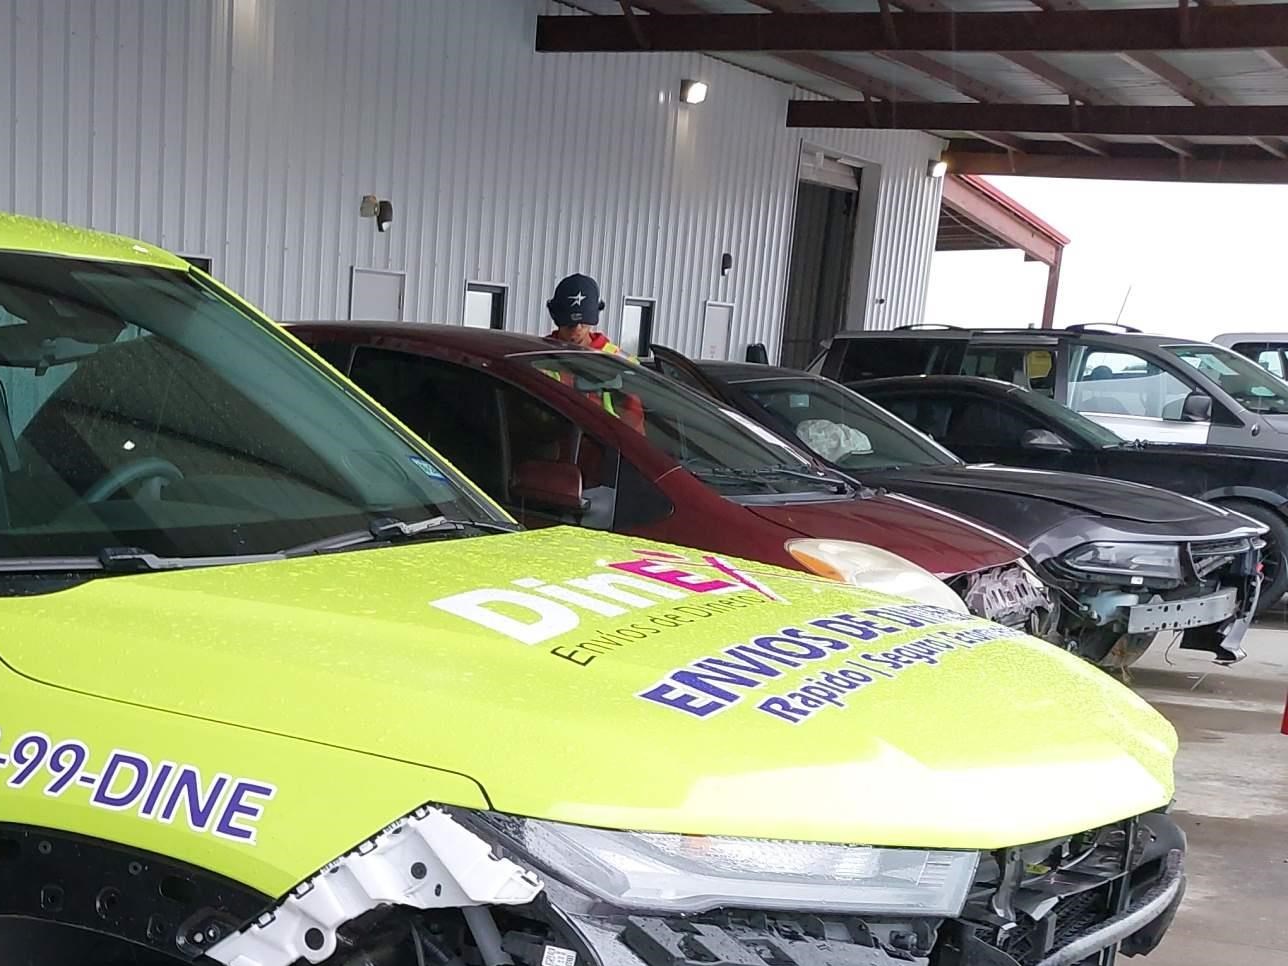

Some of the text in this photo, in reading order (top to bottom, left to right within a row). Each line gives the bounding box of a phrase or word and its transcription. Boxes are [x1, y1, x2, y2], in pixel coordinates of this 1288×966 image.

[550, 619, 661, 667] Envíos
[649, 609, 694, 629] de
[640, 627, 851, 718] ENVIOS
[813, 611, 901, 641] DE
[758, 666, 872, 723] Rapido
[860, 636, 955, 670] Seguro
